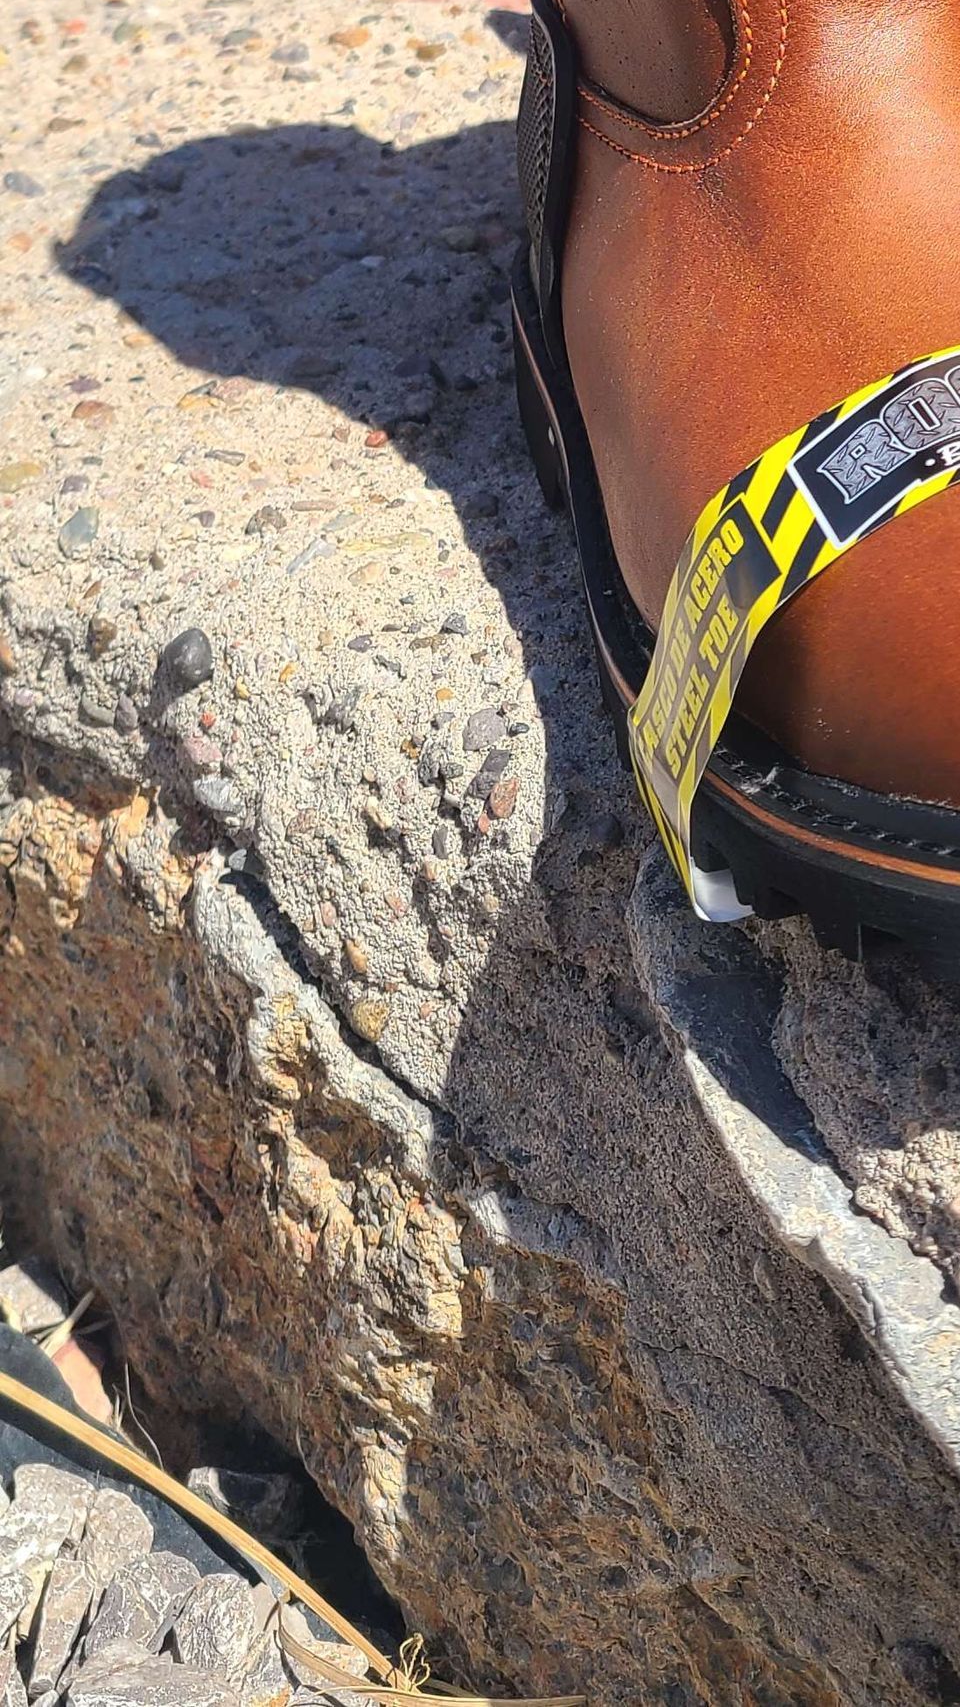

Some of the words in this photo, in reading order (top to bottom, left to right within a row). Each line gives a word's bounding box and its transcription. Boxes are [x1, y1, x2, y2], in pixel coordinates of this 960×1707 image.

[669, 617, 692, 675] DE
[689, 518, 746, 634] ACERO
[665, 660, 710, 780] STEEL
[699, 592, 739, 676] TOE
